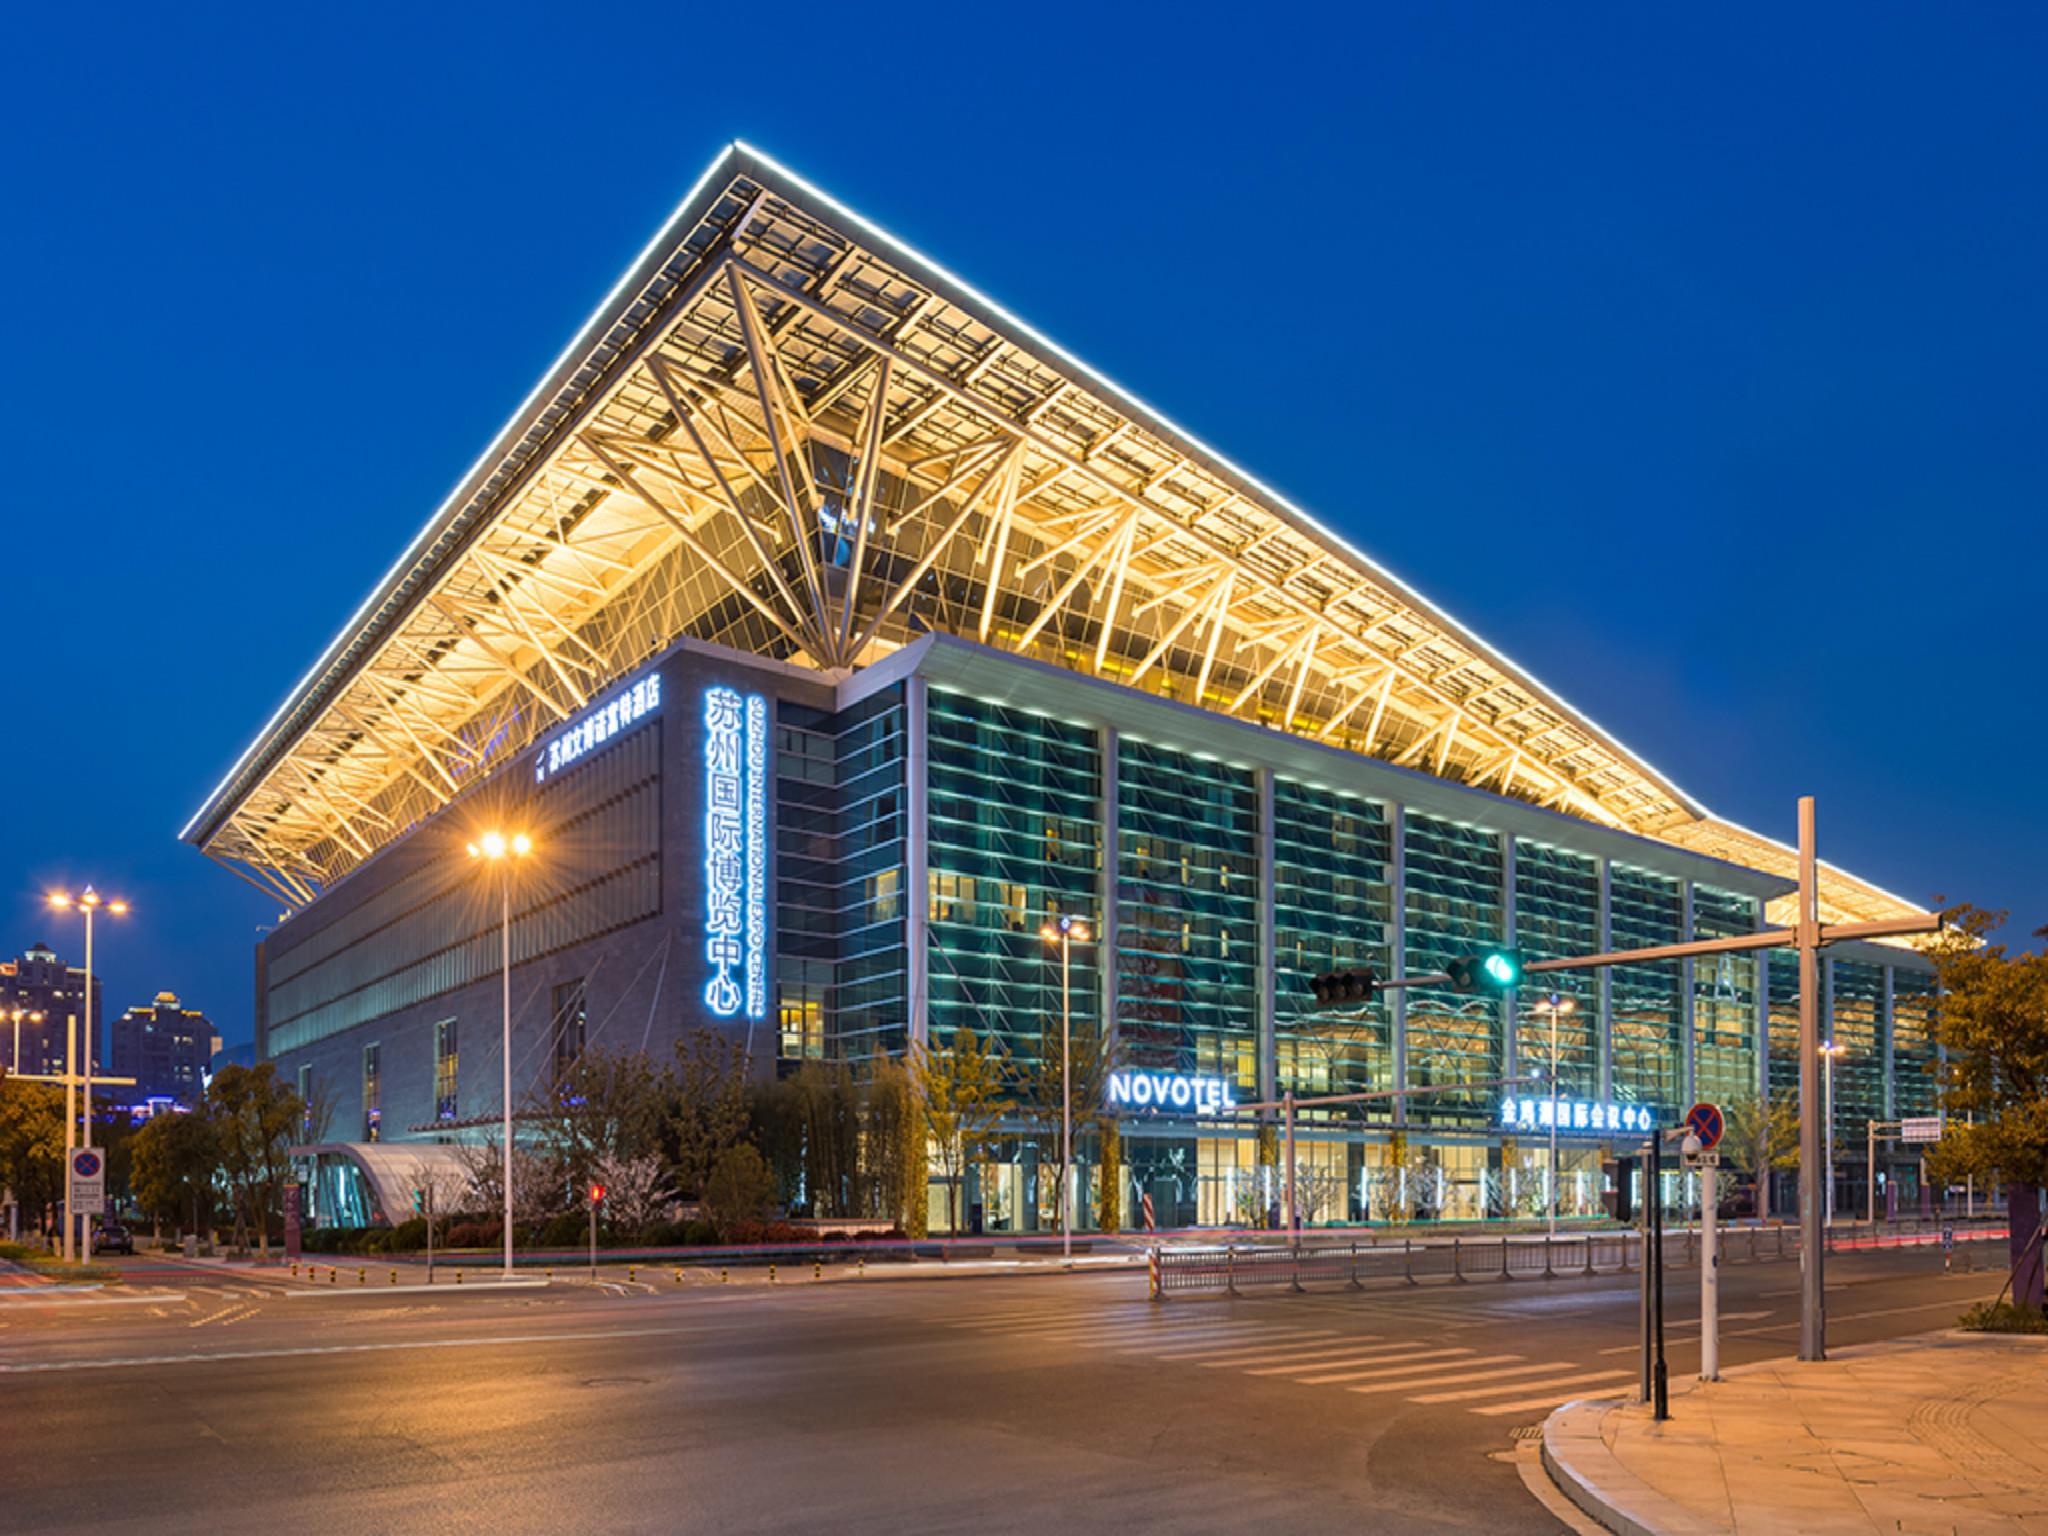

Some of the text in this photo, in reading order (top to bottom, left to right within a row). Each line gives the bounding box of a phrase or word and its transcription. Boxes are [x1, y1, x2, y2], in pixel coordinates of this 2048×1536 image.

[750, 696, 765, 768] SUZHOU
[708, 689, 743, 1012] 苏州国际博览中心
[750, 770, 765, 900] INTERNATIONAL
[750, 903, 765, 947] EXPO
[1110, 1074, 1236, 1107] NOVOTEL
